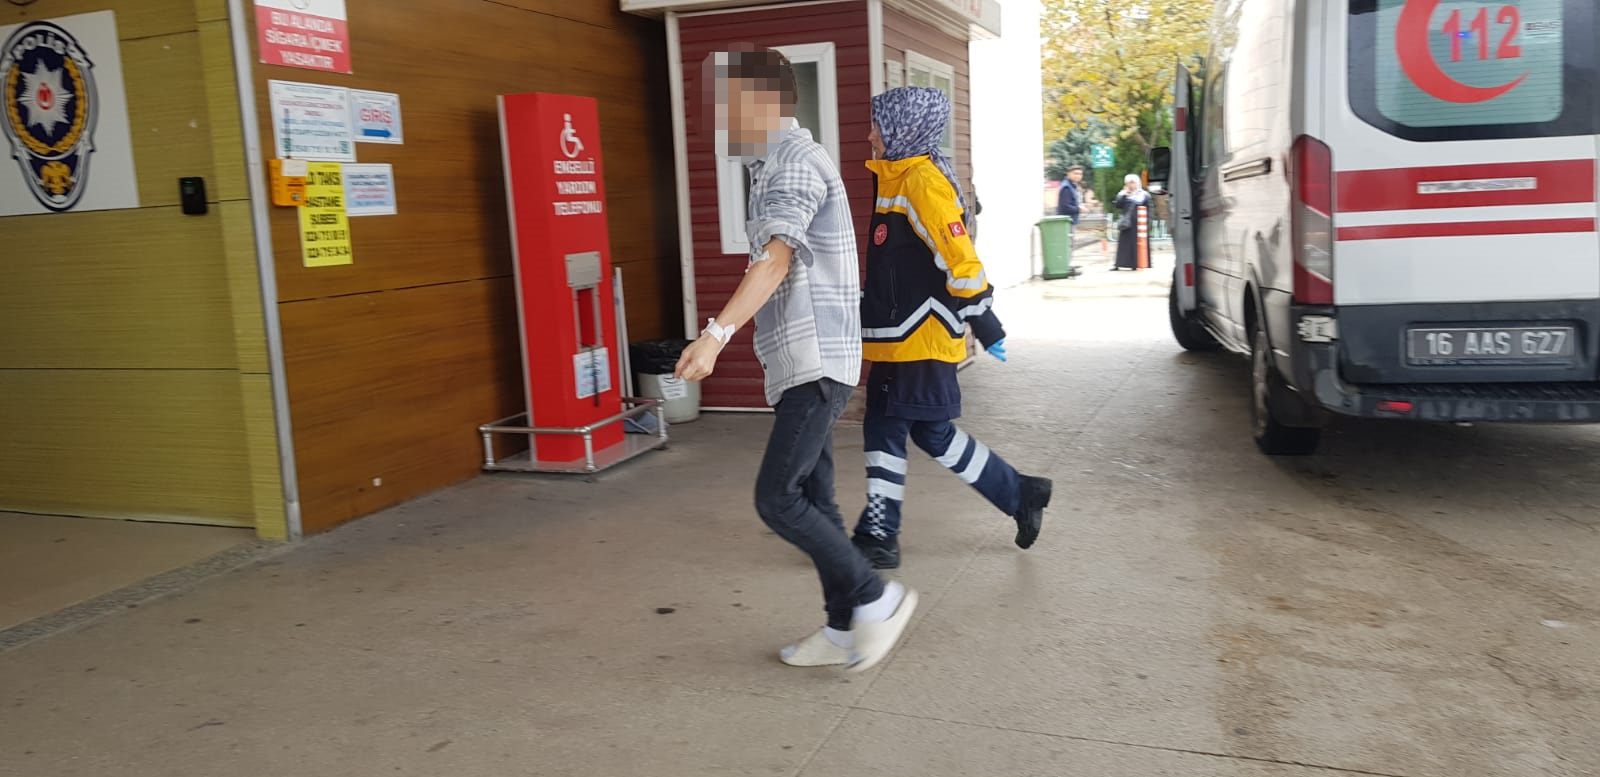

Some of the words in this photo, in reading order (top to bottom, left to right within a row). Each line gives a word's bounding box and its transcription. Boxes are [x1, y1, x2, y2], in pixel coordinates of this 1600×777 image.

[270, 11, 289, 26] BU
[289, 15, 335, 33] ALANDA
[1441, 4, 1522, 62] 112
[12, 31, 66, 60] POLİS
[264, 27, 307, 46] SİGARA
[308, 33, 345, 53] İÇMEK
[279, 50, 335, 69] YASAKTIR
[553, 157, 596, 174] ENGELLİ
[555, 181, 597, 194] YARDIM
[552, 201, 602, 216] TELEFONU
[1426, 332, 1453, 355] 16
[1464, 331, 1512, 355] AAS
[1521, 331, 1566, 355] 627
